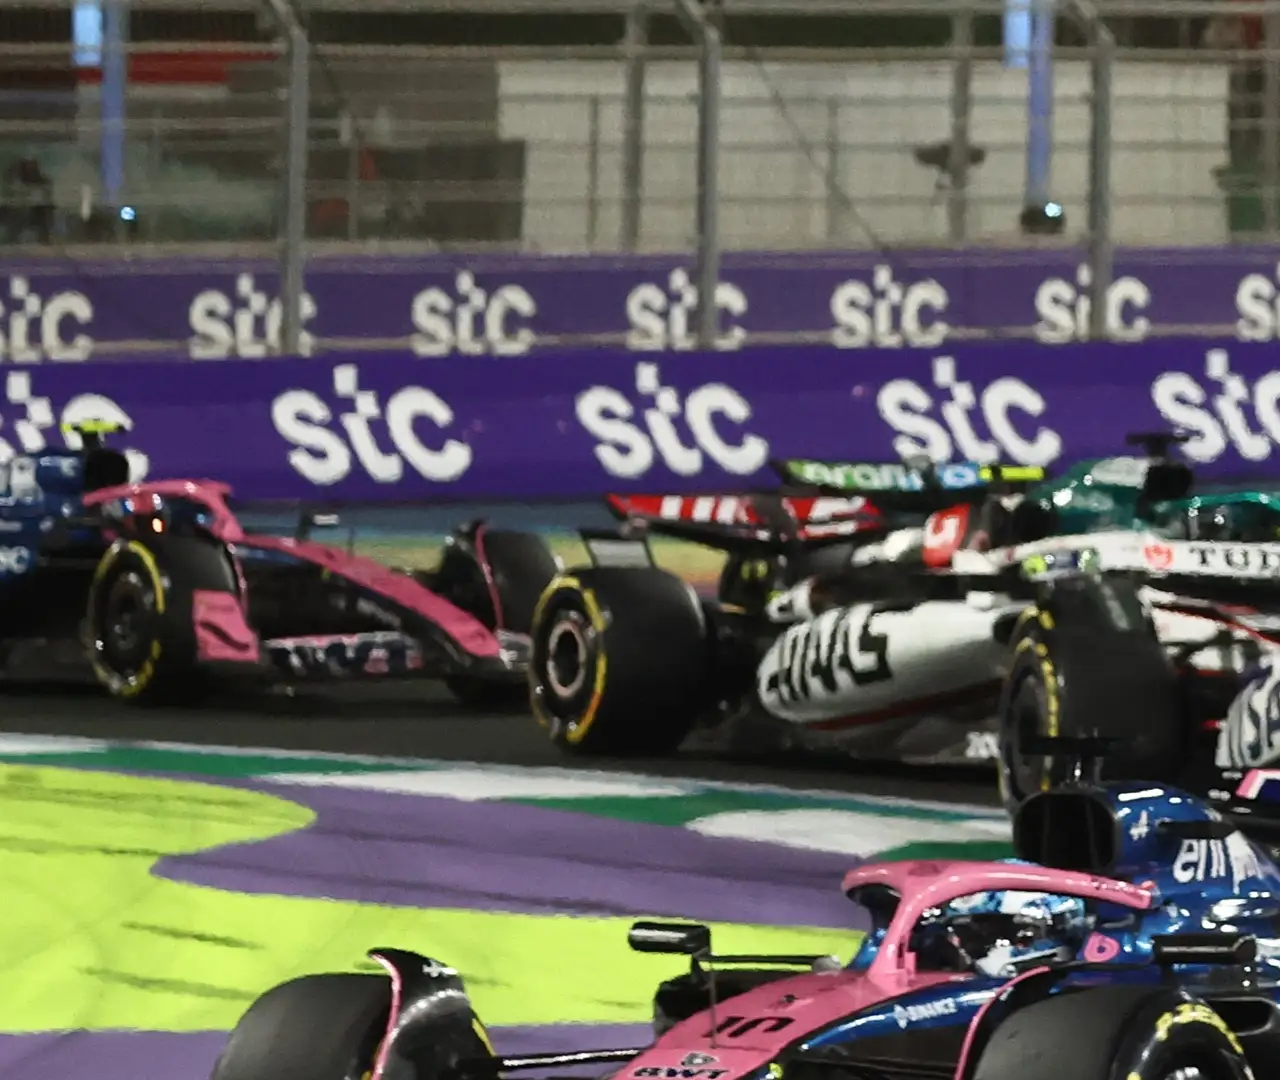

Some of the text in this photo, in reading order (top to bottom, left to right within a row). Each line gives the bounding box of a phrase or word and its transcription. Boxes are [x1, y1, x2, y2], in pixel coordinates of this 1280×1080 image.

[0, 274, 94, 362] tc
[411, 269, 537, 356] stc
[830, 264, 949, 349] stc
[272, 363, 473, 484] stc
[575, 361, 769, 479] stc
[876, 355, 1062, 467] stc
